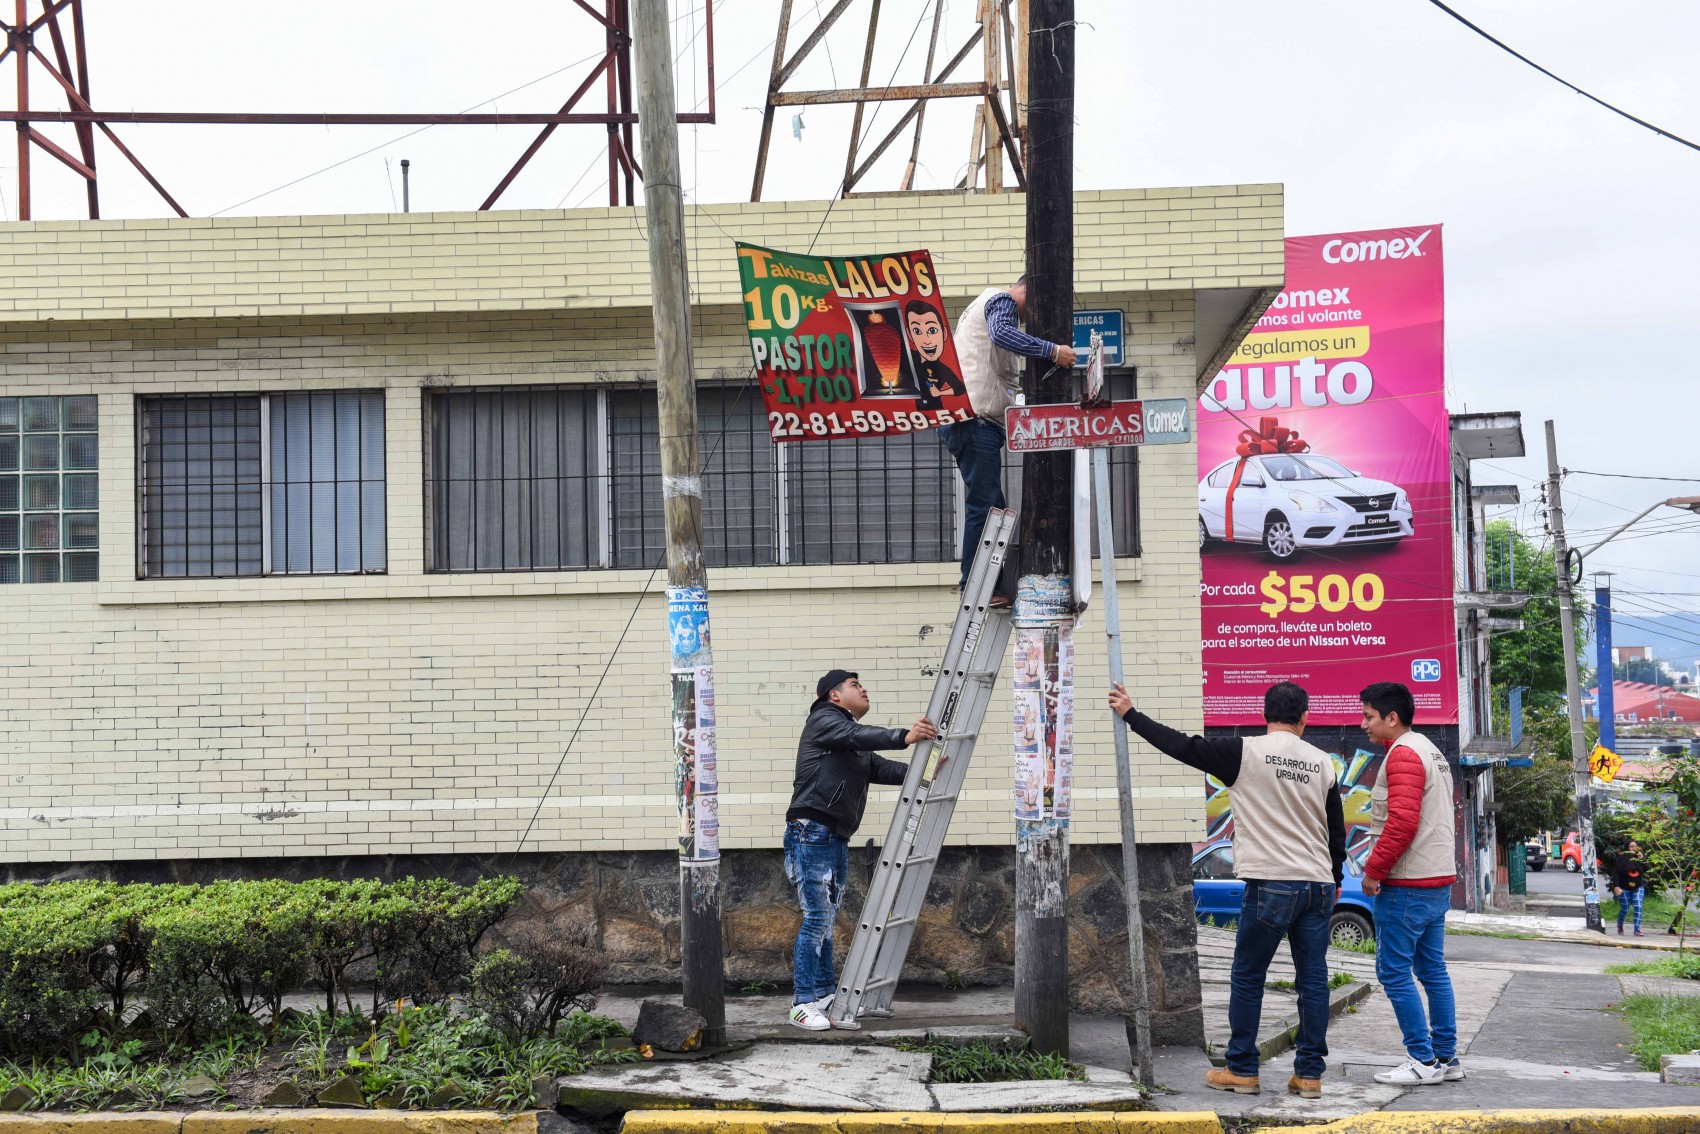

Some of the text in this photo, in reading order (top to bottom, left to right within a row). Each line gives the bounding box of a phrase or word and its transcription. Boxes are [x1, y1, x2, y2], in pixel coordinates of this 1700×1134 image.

[1322, 229, 1432, 264] Comex
[738, 248, 830, 286] Takizas
[744, 284, 800, 331] 10
[1074, 316, 1104, 326] ERICAS
[1253, 309, 1362, 327] mos al volante
[751, 333, 853, 371] PASTOR
[1235, 336, 1356, 359] regalamos un
[764, 375, 851, 409] $1,700
[1200, 355, 1373, 413] auto
[769, 407, 975, 438] 22-81-59-59-51
[1011, 413, 1143, 440] AMERICAS
[1146, 405, 1187, 434] Comex
[1367, 516, 1388, 525] Comex
[1200, 570, 1385, 618] Por cada $500
[1201, 634, 1386, 650] para el sorteo de un Nissan Versa
[1217, 621, 1372, 636] de compra, lleváte un boleto
[1413, 661, 1440, 680] PPG
[1265, 755, 1320, 774] DESARROLLO
[1276, 768, 1310, 784] URBANO
